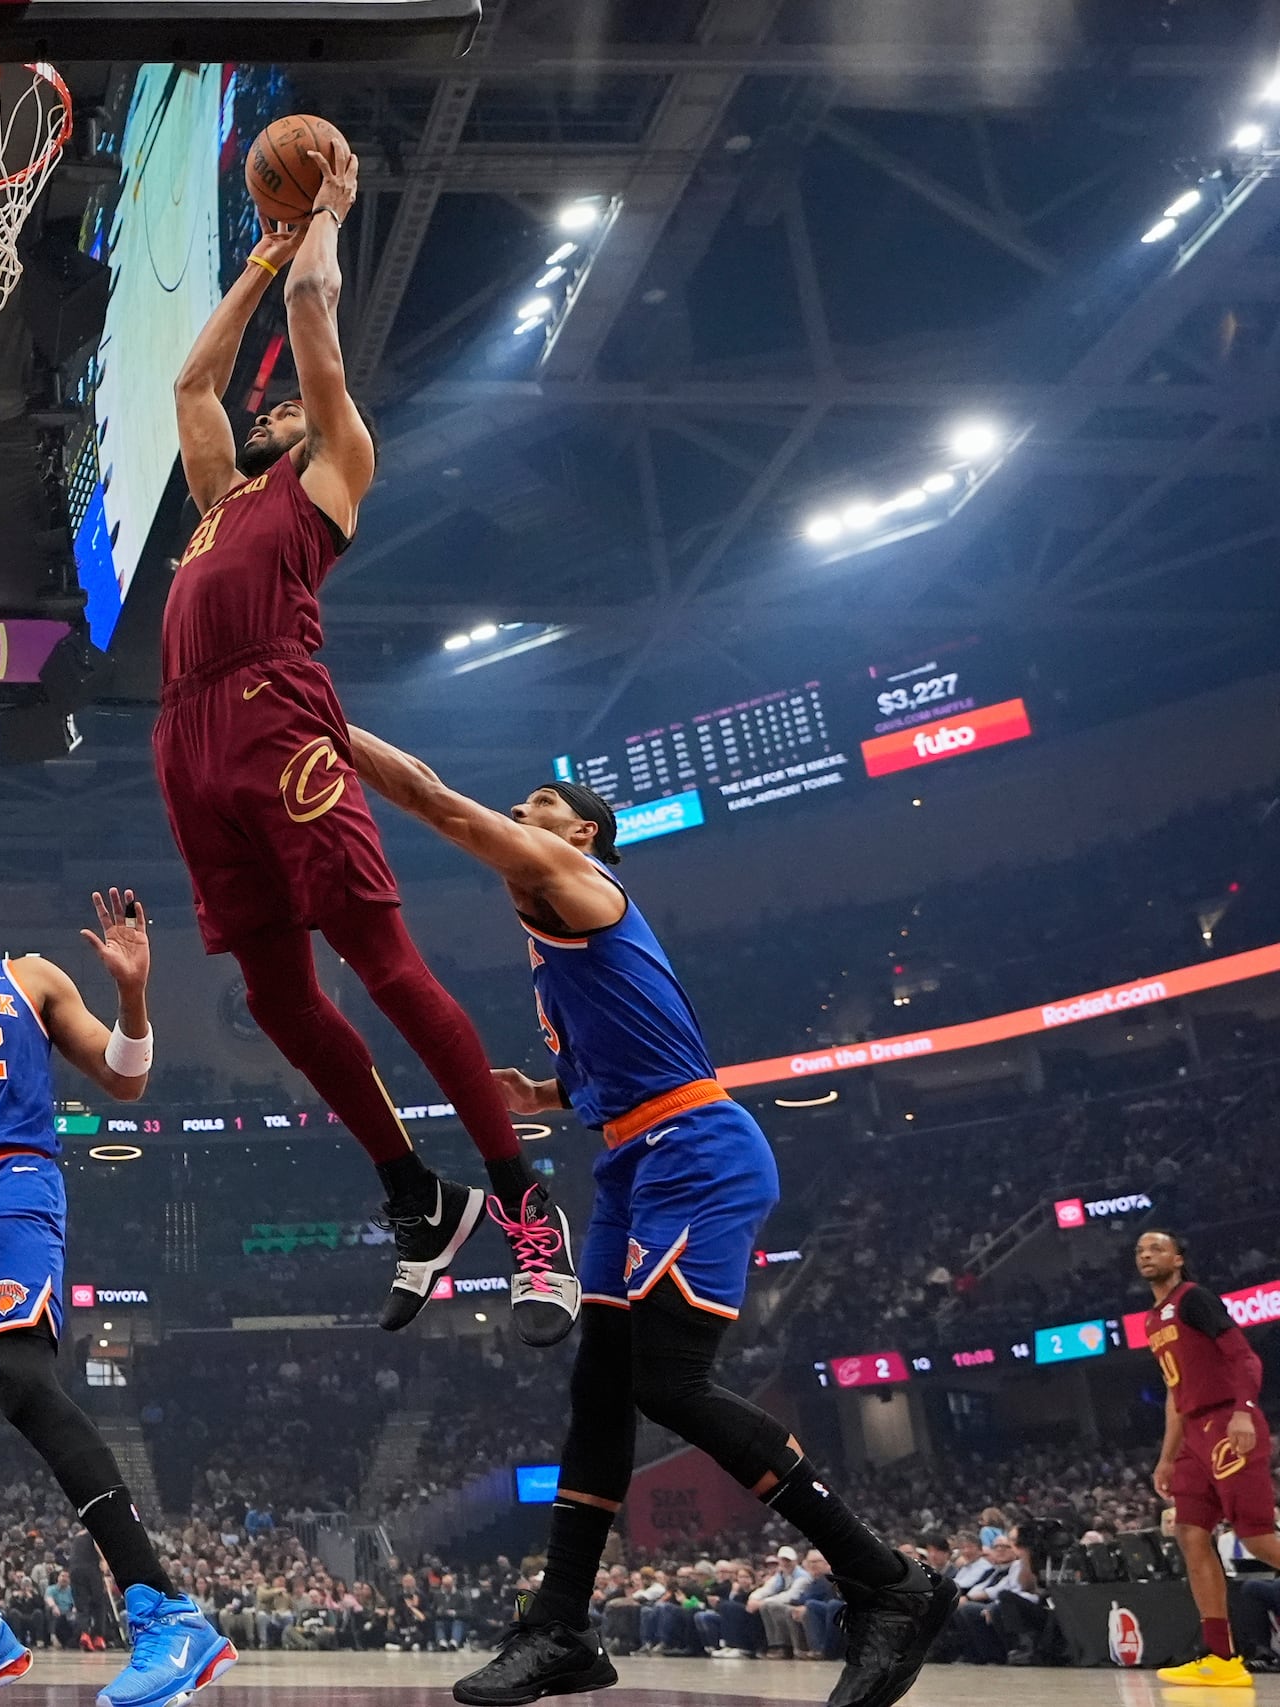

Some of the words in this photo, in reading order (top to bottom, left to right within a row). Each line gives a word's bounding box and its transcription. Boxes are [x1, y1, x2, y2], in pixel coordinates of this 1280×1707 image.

[181, 508, 224, 567] 31
[877, 673, 958, 716] $3,227
[913, 726, 976, 757] fubo
[719, 782, 740, 796] THE
[740, 775, 763, 791] LINE
[763, 770, 786, 784] FOR
[785, 764, 807, 778] THE
[1042, 980, 1166, 1028] Rocket.com
[791, 1055, 832, 1074] Own
[835, 1047, 868, 1066] the
[870, 1034, 932, 1060] Dream
[56, 1118, 67, 1132] 2
[108, 1119, 138, 1132] FG%
[143, 1120, 161, 1133] 33
[183, 1118, 224, 1132] FOULS
[234, 1116, 243, 1130] 1
[264, 1114, 290, 1128] TOL
[298, 1112, 308, 1126] 7
[1085, 1194, 1152, 1218] TOYOTA
[766, 1250, 802, 1262] TOYOTA
[96, 1290, 148, 1304] TOYOTA
[454, 1276, 508, 1294] TOYOTA
[819, 1374, 828, 1387] 1
[875, 1358, 890, 1378] 2
[1050, 1335, 1063, 1354] 2
[1111, 1331, 1120, 1347] 1
